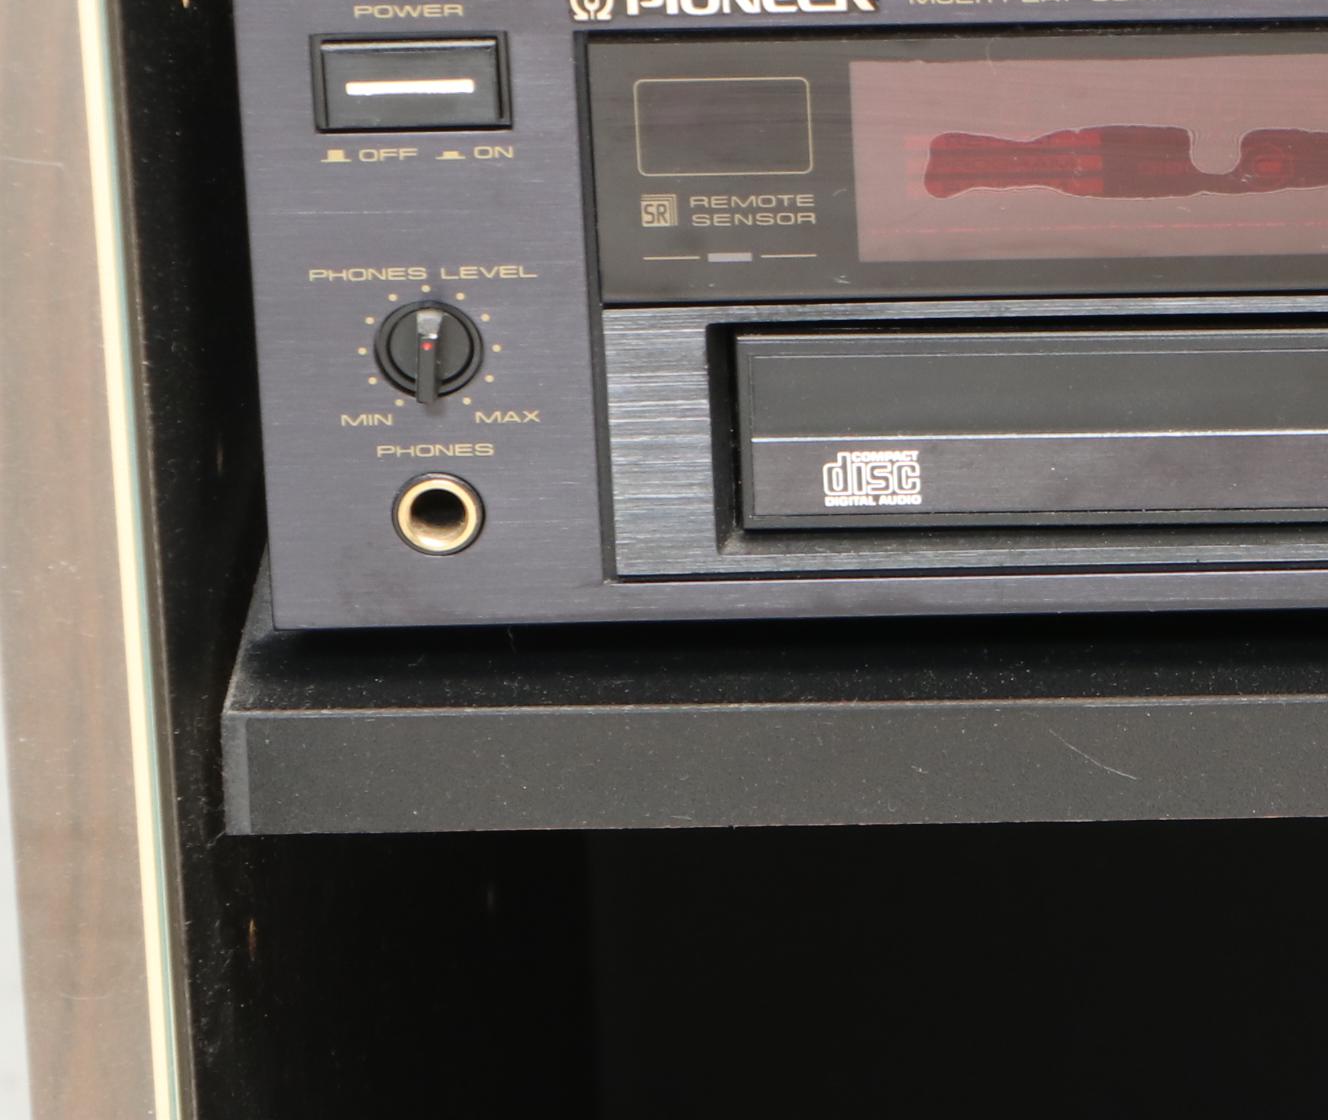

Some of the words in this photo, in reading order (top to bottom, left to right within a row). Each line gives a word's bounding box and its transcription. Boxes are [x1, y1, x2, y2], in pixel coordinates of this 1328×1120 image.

[354, 4, 464, 18] POWER
[359, 148, 417, 161] OFF
[474, 146, 514, 159] ON
[689, 194, 814, 208] REMOTE
[692, 212, 815, 226] SENSOR
[309, 267, 427, 281] PHONES
[441, 265, 537, 279] LEVEL
[341, 414, 394, 426] MIN
[475, 410, 539, 423] MAX
[377, 443, 495, 457] PHONES
[823, 453, 920, 494] disc
